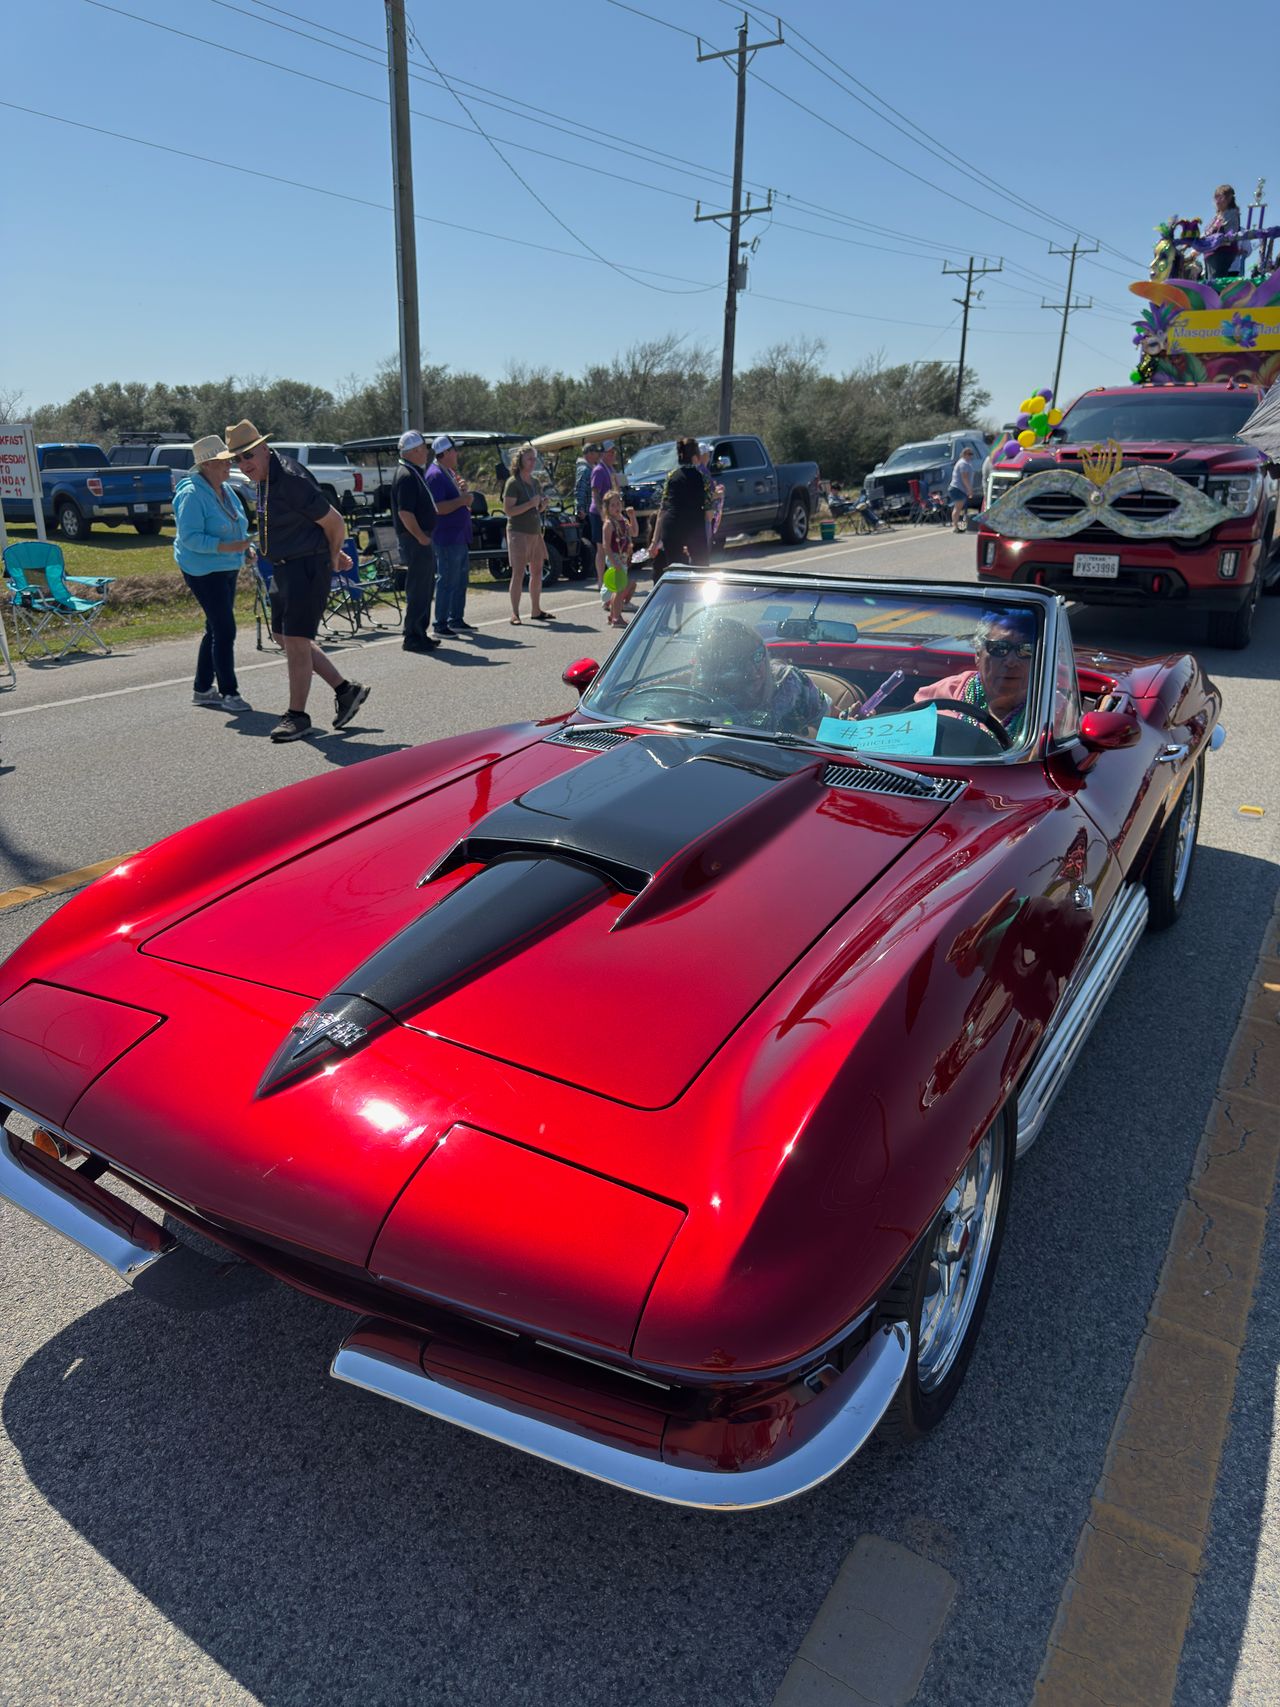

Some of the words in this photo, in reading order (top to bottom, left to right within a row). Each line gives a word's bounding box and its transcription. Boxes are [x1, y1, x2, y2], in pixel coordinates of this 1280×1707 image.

[1174, 326, 1226, 339] Masque
[0, 475, 26, 486] NDAY
[840, 720, 913, 740] #324
